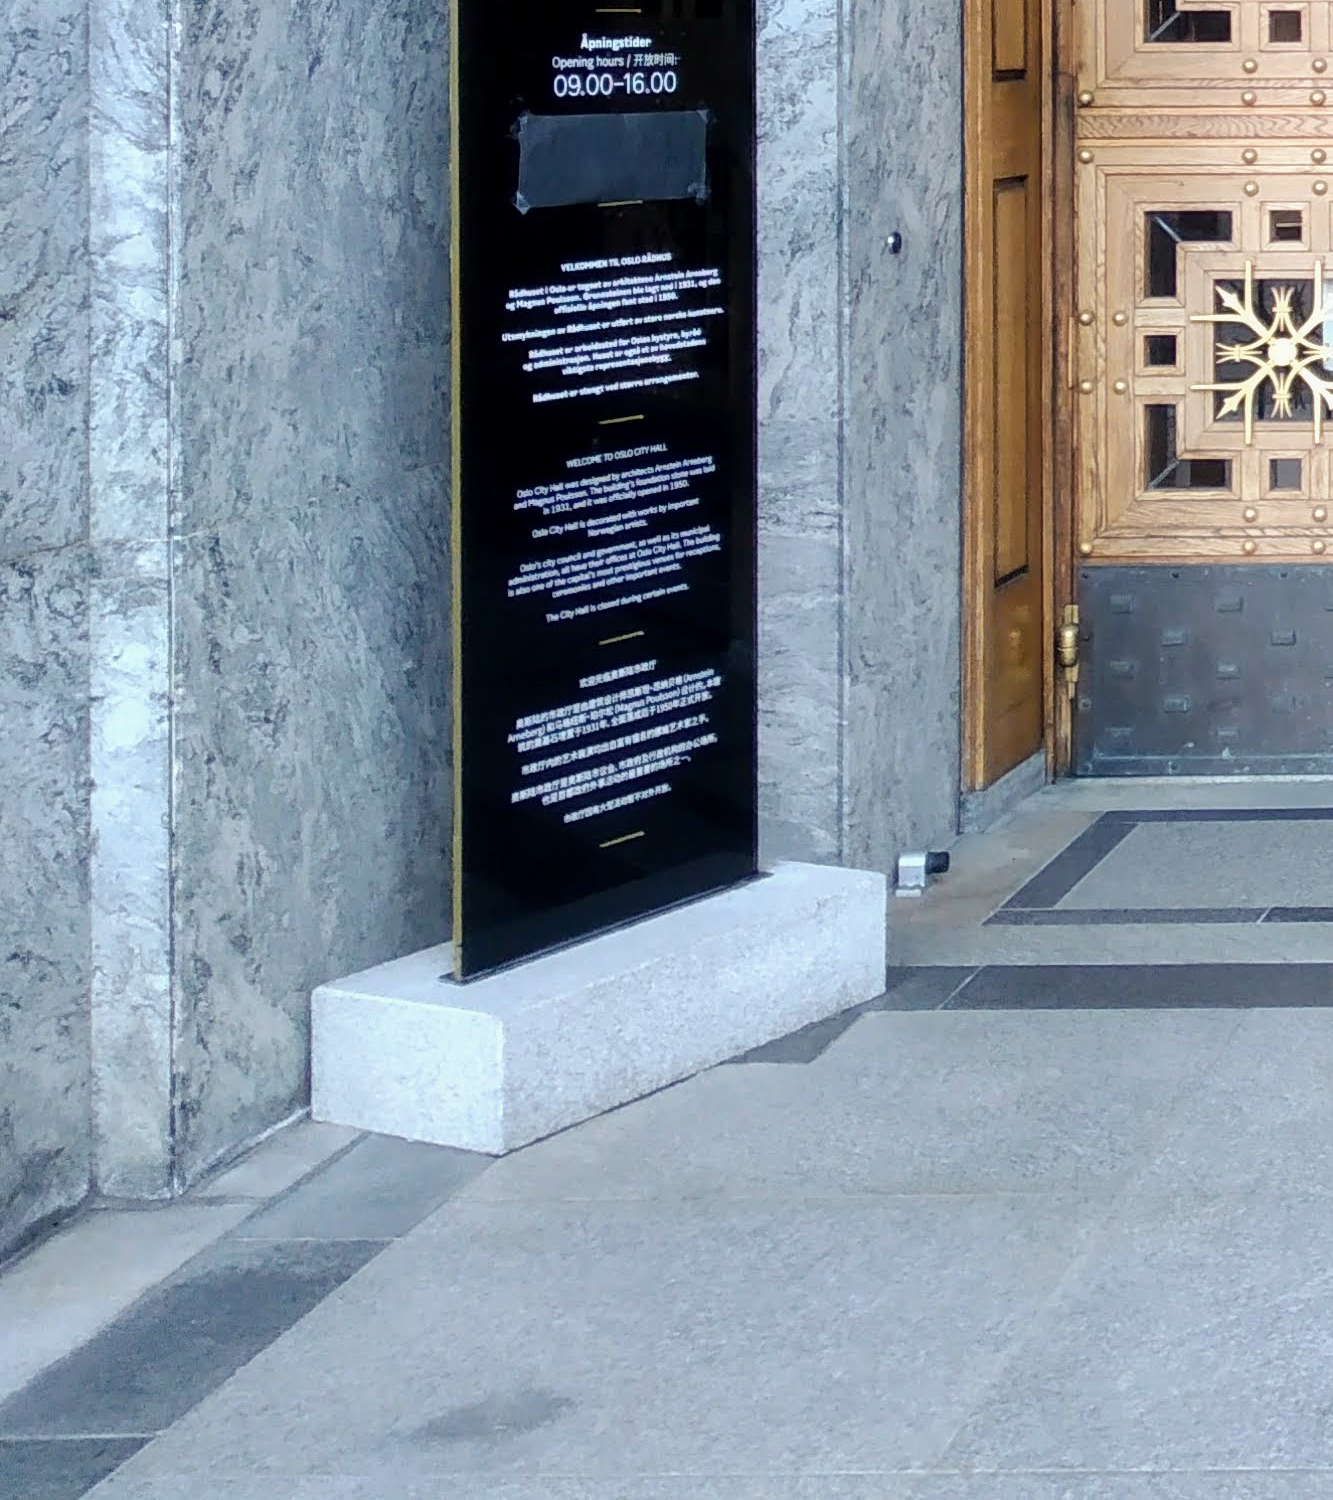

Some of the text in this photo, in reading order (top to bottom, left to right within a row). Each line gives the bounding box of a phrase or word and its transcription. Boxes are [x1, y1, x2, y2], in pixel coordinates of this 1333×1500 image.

[581, 33, 651, 51] Åpningstider
[552, 56, 594, 70] Opening
[596, 56, 624, 67] hours
